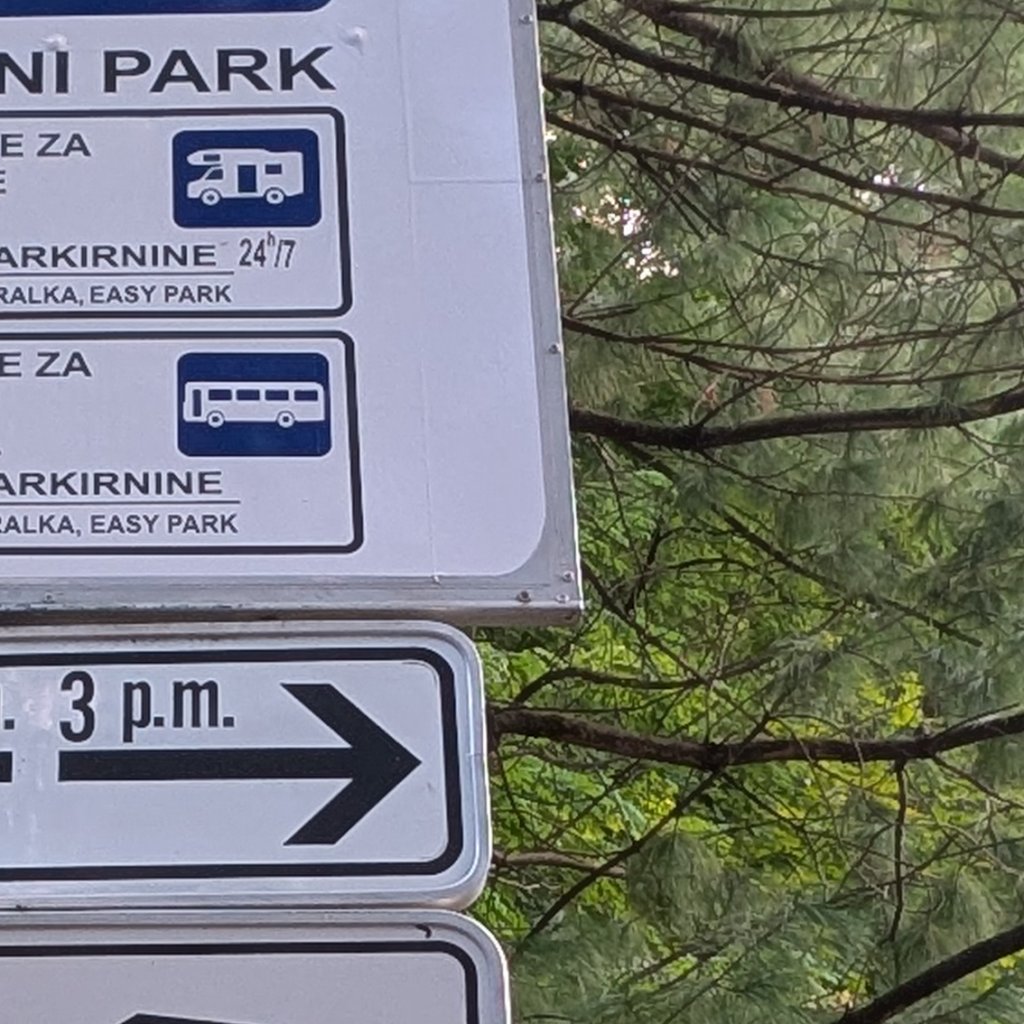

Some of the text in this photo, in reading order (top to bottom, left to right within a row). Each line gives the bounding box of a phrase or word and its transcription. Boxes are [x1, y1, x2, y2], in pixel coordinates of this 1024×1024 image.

[103, 47, 336, 94] PARK
[37, 133, 91, 158] ZA
[91, 285, 158, 304] EASY
[164, 285, 232, 304] PARK
[35, 352, 92, 377] ZA
[90, 515, 159, 534] EASY
[168, 514, 239, 534] PARK
[60, 670, 94, 743] 3
[123, 679, 234, 743] p.m.
